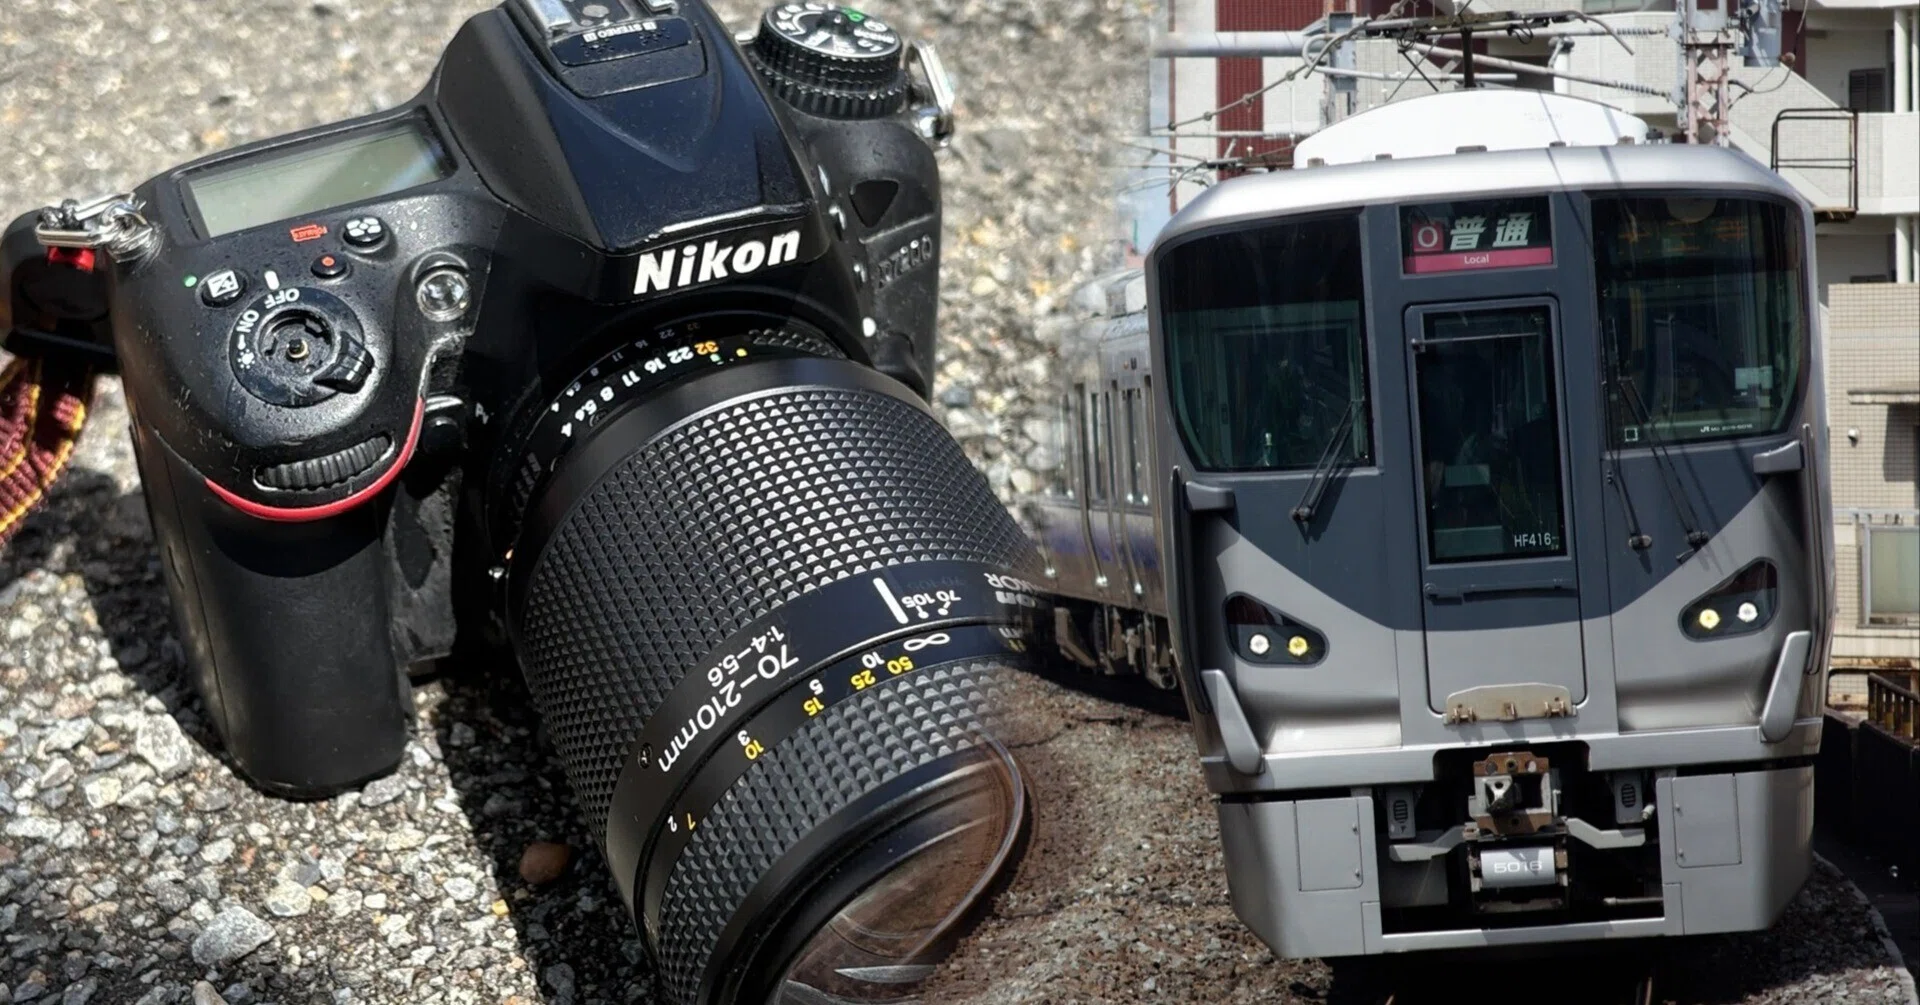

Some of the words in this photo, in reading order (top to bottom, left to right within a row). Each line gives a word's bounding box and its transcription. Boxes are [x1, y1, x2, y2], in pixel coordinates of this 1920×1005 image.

[1450, 212, 1532, 251] 普通
[633, 230, 800, 295] Nikon
[1464, 254, 1490, 265] Local
[264, 287, 300, 310] OFF
[236, 309, 260, 334] ON
[667, 346, 694, 364] 22
[694, 340, 719, 355] 32
[644, 357, 667, 374] 16
[621, 370, 641, 387] 11
[600, 386, 614, 401] 8
[1514, 532, 1551, 548] HF416
[901, 593, 935, 609] 105
[936, 590, 961, 602] 70
[707, 625, 785, 688] 1:4-5.6
[862, 652, 885, 669] 10
[887, 656, 914, 675] 50
[809, 679, 824, 695] 5
[851, 670, 876, 690] 25
[658, 643, 800, 773] 70-210mm
[803, 697, 825, 716] 15
[737, 729, 751, 746] 3
[744, 740, 764, 760] 10
[668, 815, 678, 832] 2
[687, 813, 696, 830] 7
